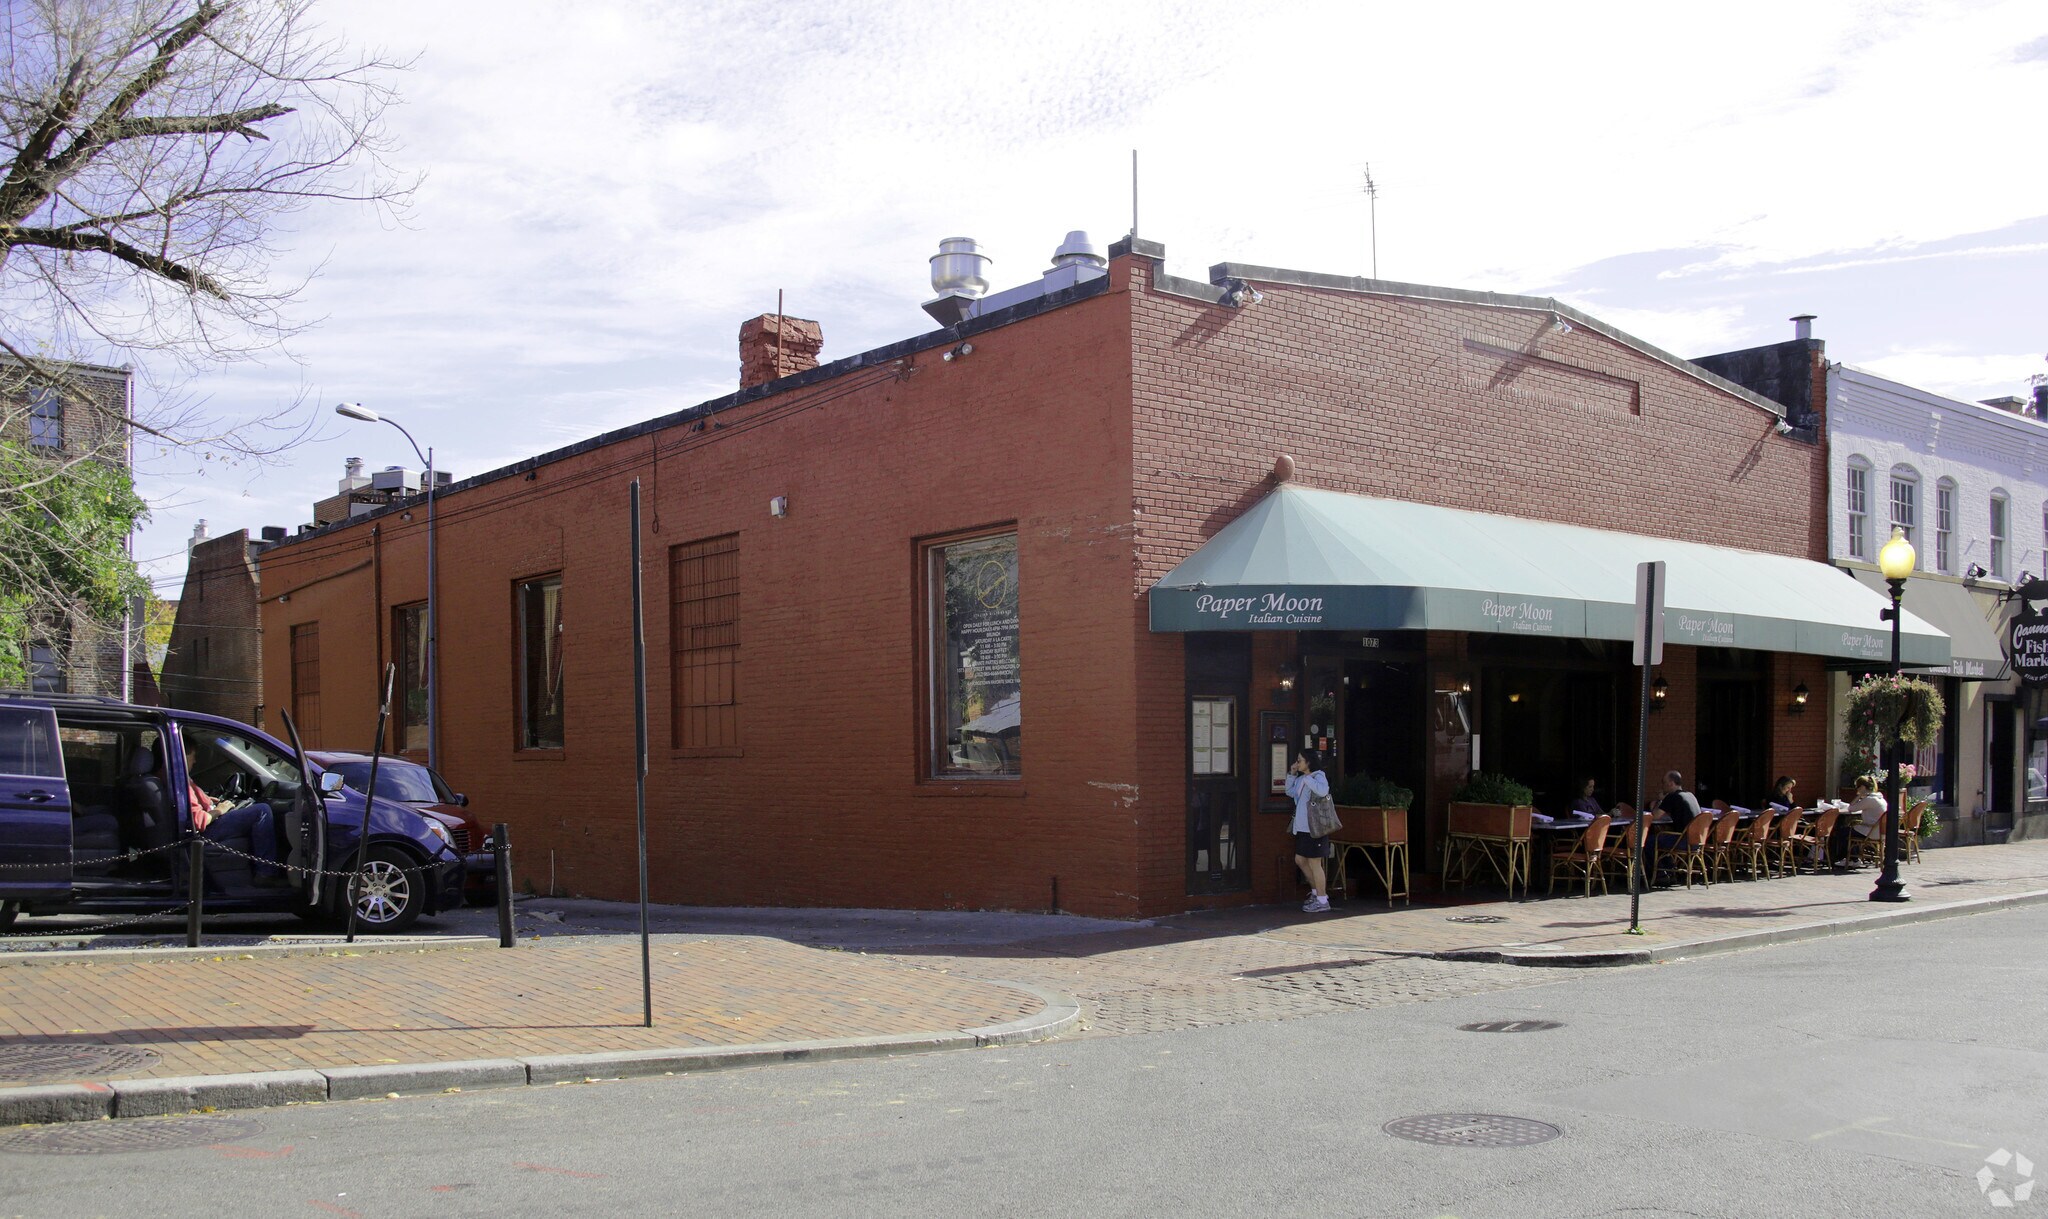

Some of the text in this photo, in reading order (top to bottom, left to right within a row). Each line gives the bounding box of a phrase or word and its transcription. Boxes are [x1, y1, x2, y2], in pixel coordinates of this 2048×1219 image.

[1196, 592, 1323, 618] Paper Moon
[1481, 599, 1552, 623] Paper Moon
[1248, 612, 1323, 624] Italian Cuisine
[1512, 620, 1552, 632] Italian Cuisine
[1679, 615, 1733, 636] Paper Moon
[1363, 637, 1379, 648] 1073
[1841, 632, 1883, 650] Paper Moon
